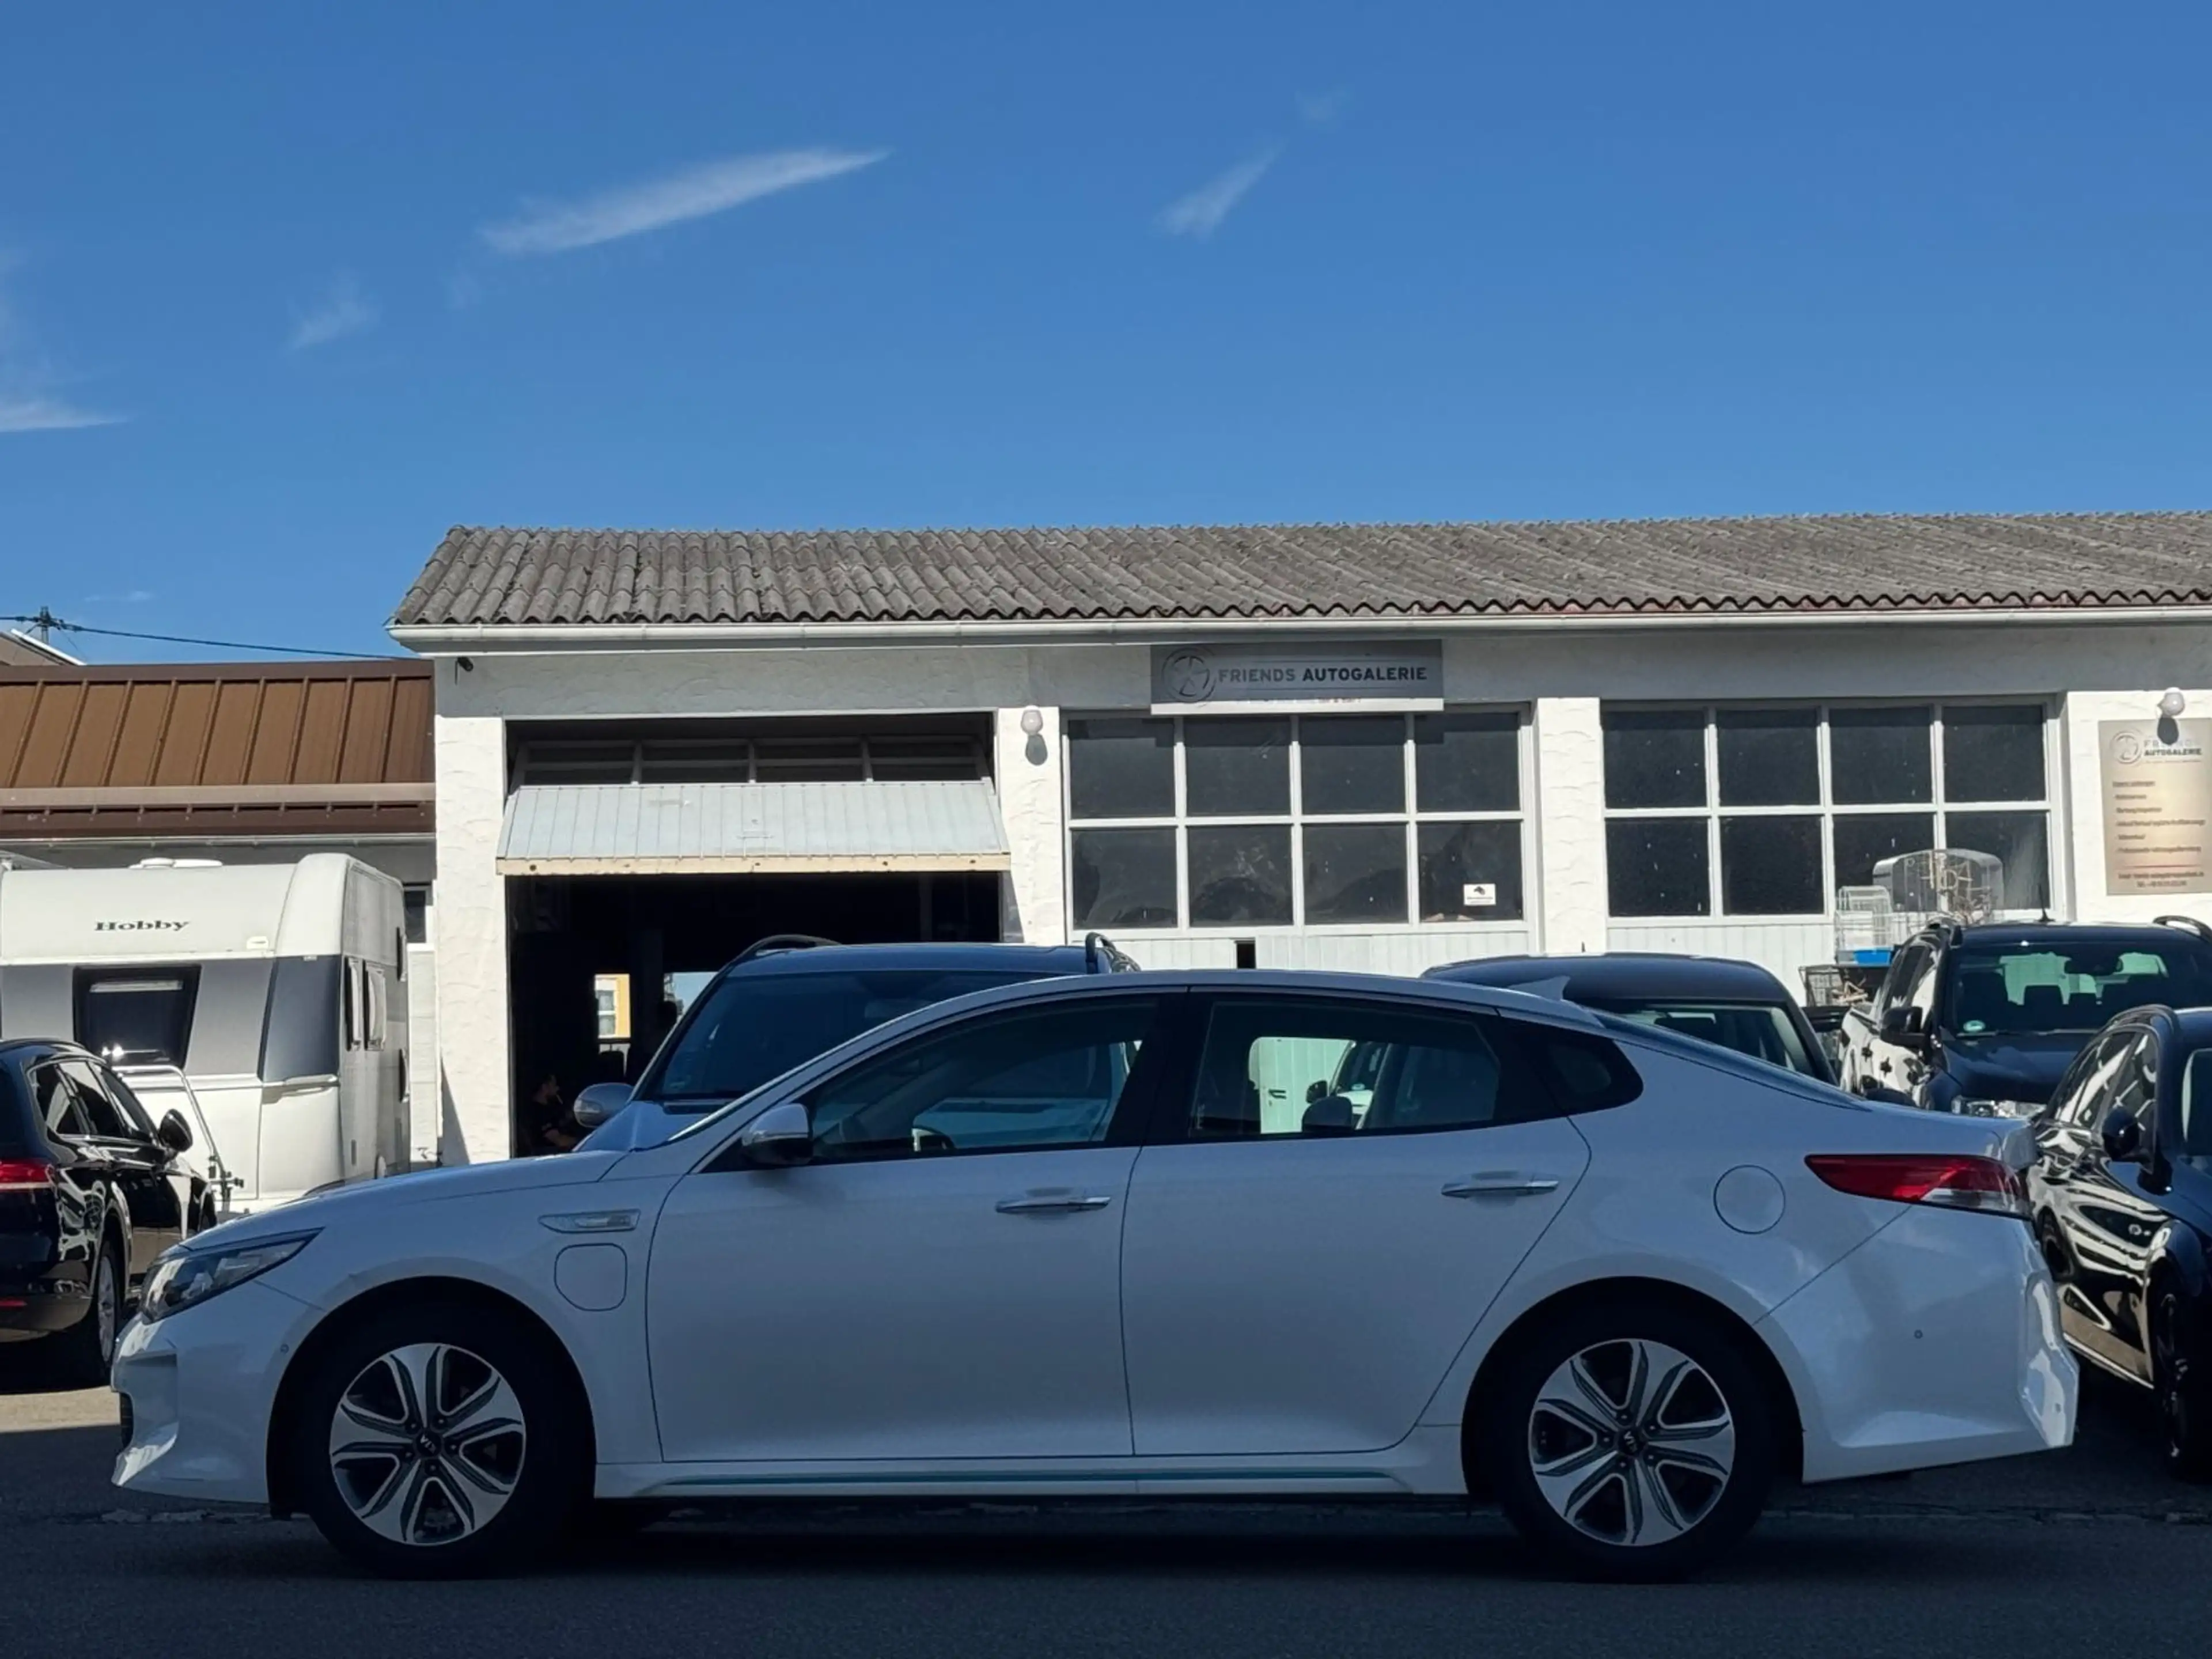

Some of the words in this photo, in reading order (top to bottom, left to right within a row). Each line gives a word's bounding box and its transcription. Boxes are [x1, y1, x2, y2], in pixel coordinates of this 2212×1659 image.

[1218, 668, 1296, 683] FRIENDS
[1302, 666, 1428, 682] AUTOGALERIE
[94, 920, 190, 931] Hobby
